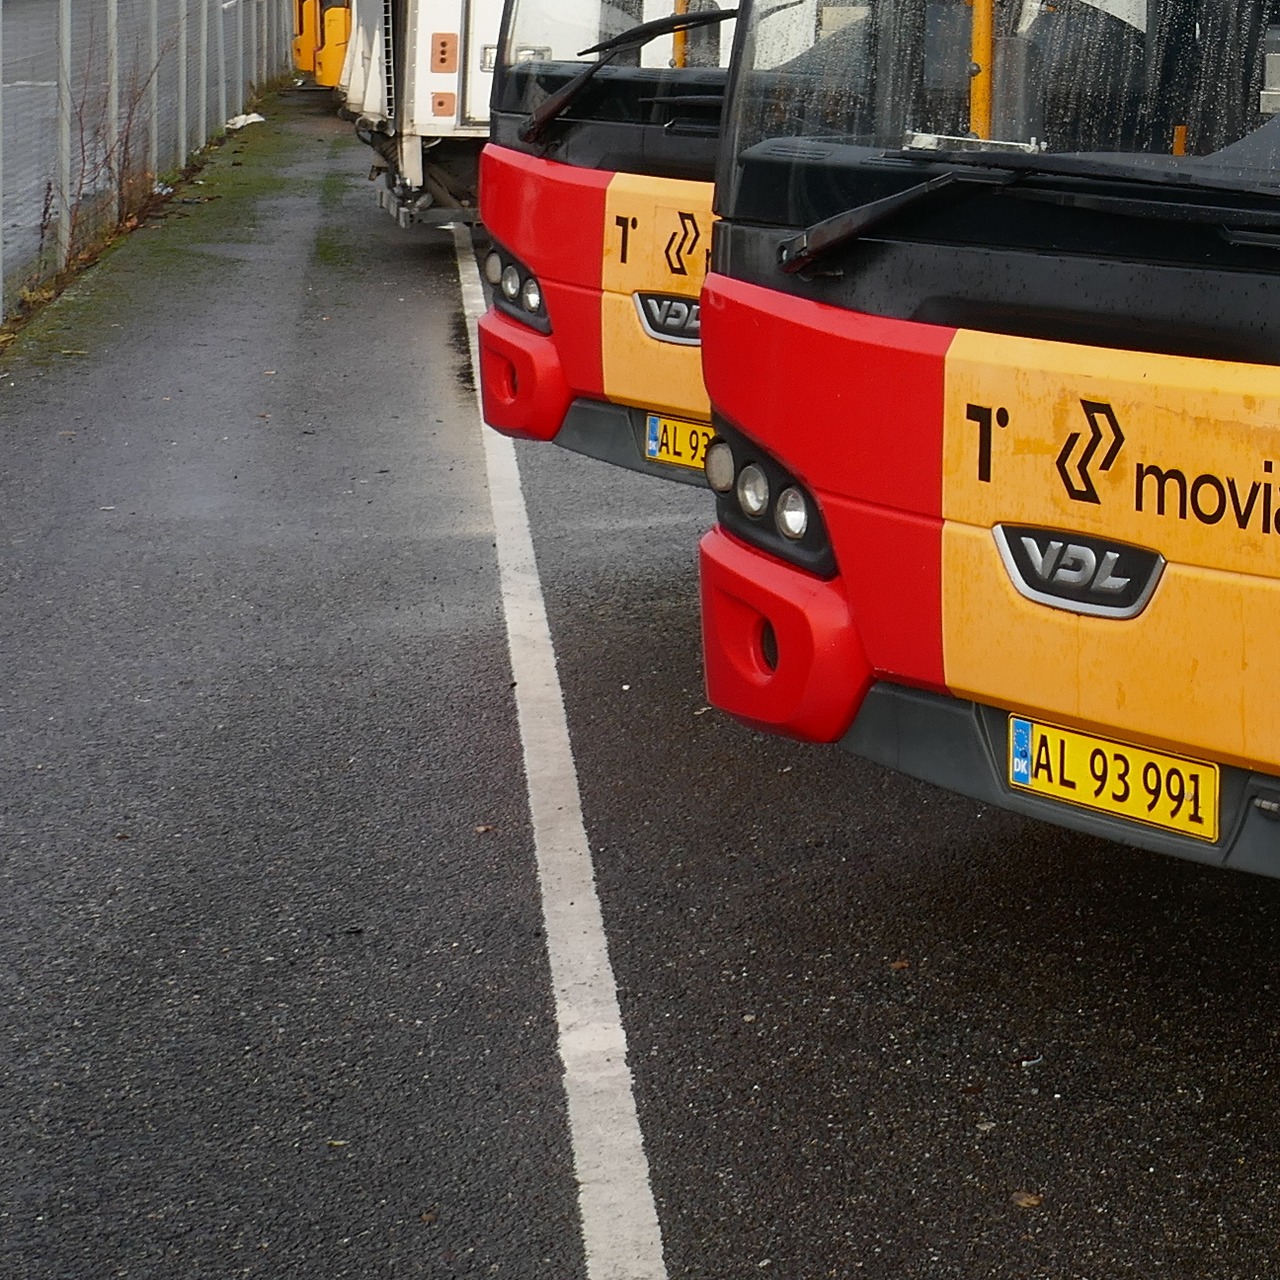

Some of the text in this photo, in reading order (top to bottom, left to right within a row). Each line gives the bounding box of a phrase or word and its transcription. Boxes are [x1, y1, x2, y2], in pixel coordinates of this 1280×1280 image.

[658, 424, 683, 460] AL
[1020, 536, 1131, 593] VDL
[1013, 756, 1028, 776] DK
[1032, 734, 1205, 825] AL 93 991
